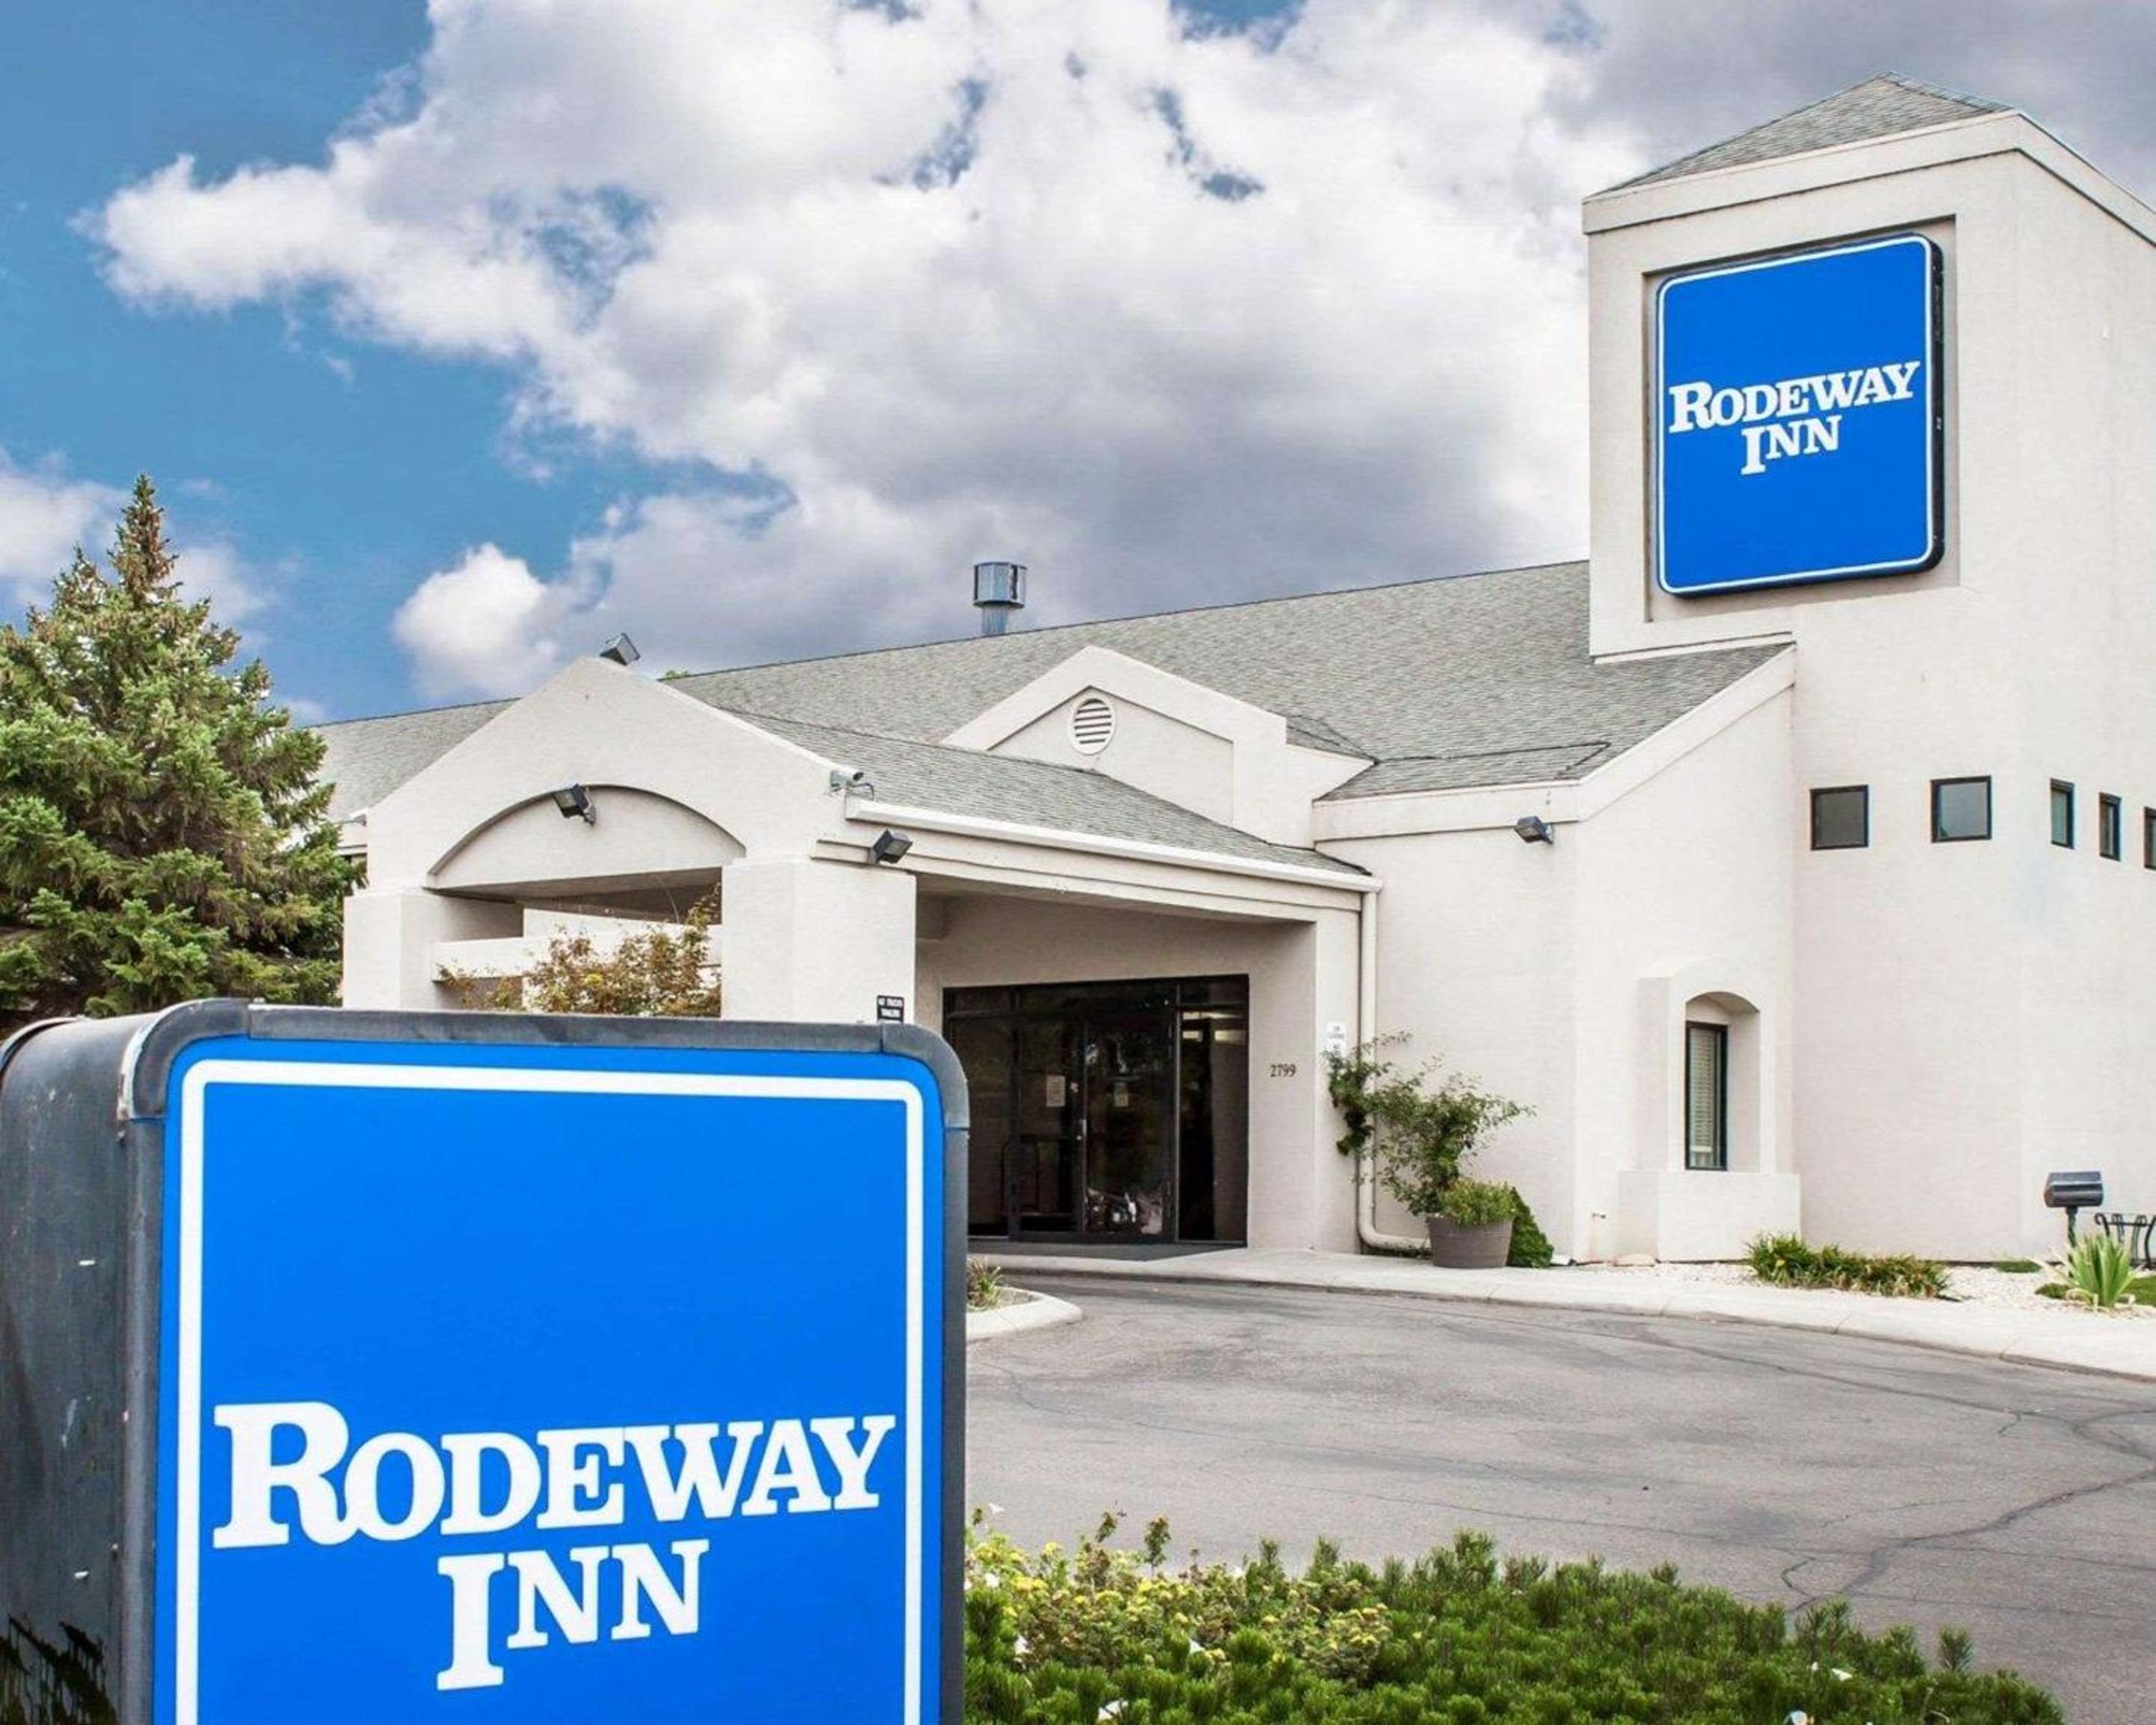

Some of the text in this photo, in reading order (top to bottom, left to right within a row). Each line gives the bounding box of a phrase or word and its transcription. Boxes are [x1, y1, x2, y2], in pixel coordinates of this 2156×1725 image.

[1669, 361, 1920, 433] RODEWAY
[1741, 416, 1842, 475] INN
[1270, 1063, 1296, 1077] 2799
[213, 1402, 895, 1548] RODEWAY
[437, 1539, 709, 1691] INN
